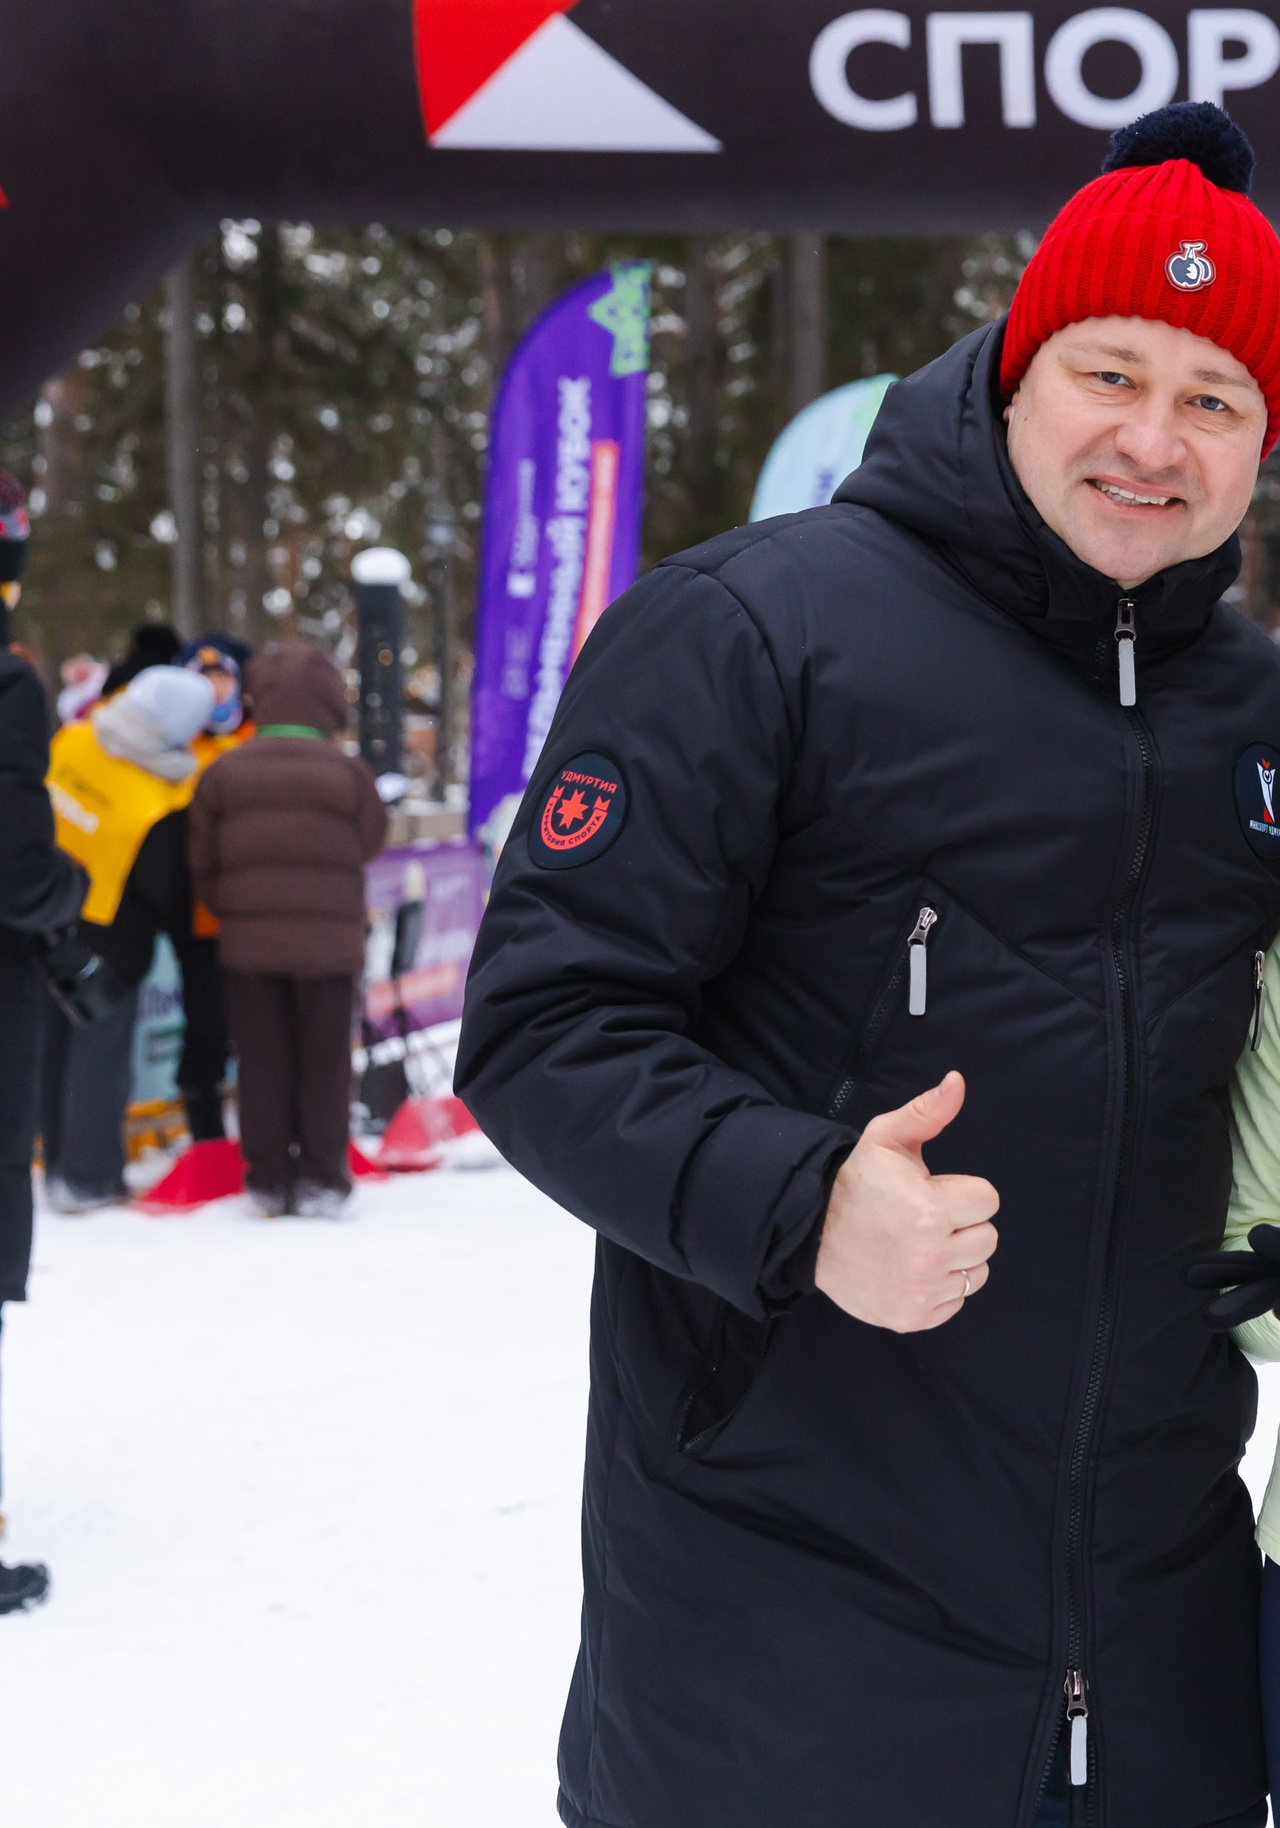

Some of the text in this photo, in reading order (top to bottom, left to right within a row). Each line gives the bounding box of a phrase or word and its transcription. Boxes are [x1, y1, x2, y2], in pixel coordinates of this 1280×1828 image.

[554, 376, 592, 511] КУБОК
[560, 770, 618, 794] УДМУРТИЯ
[568, 815, 602, 845] СПОРТА
